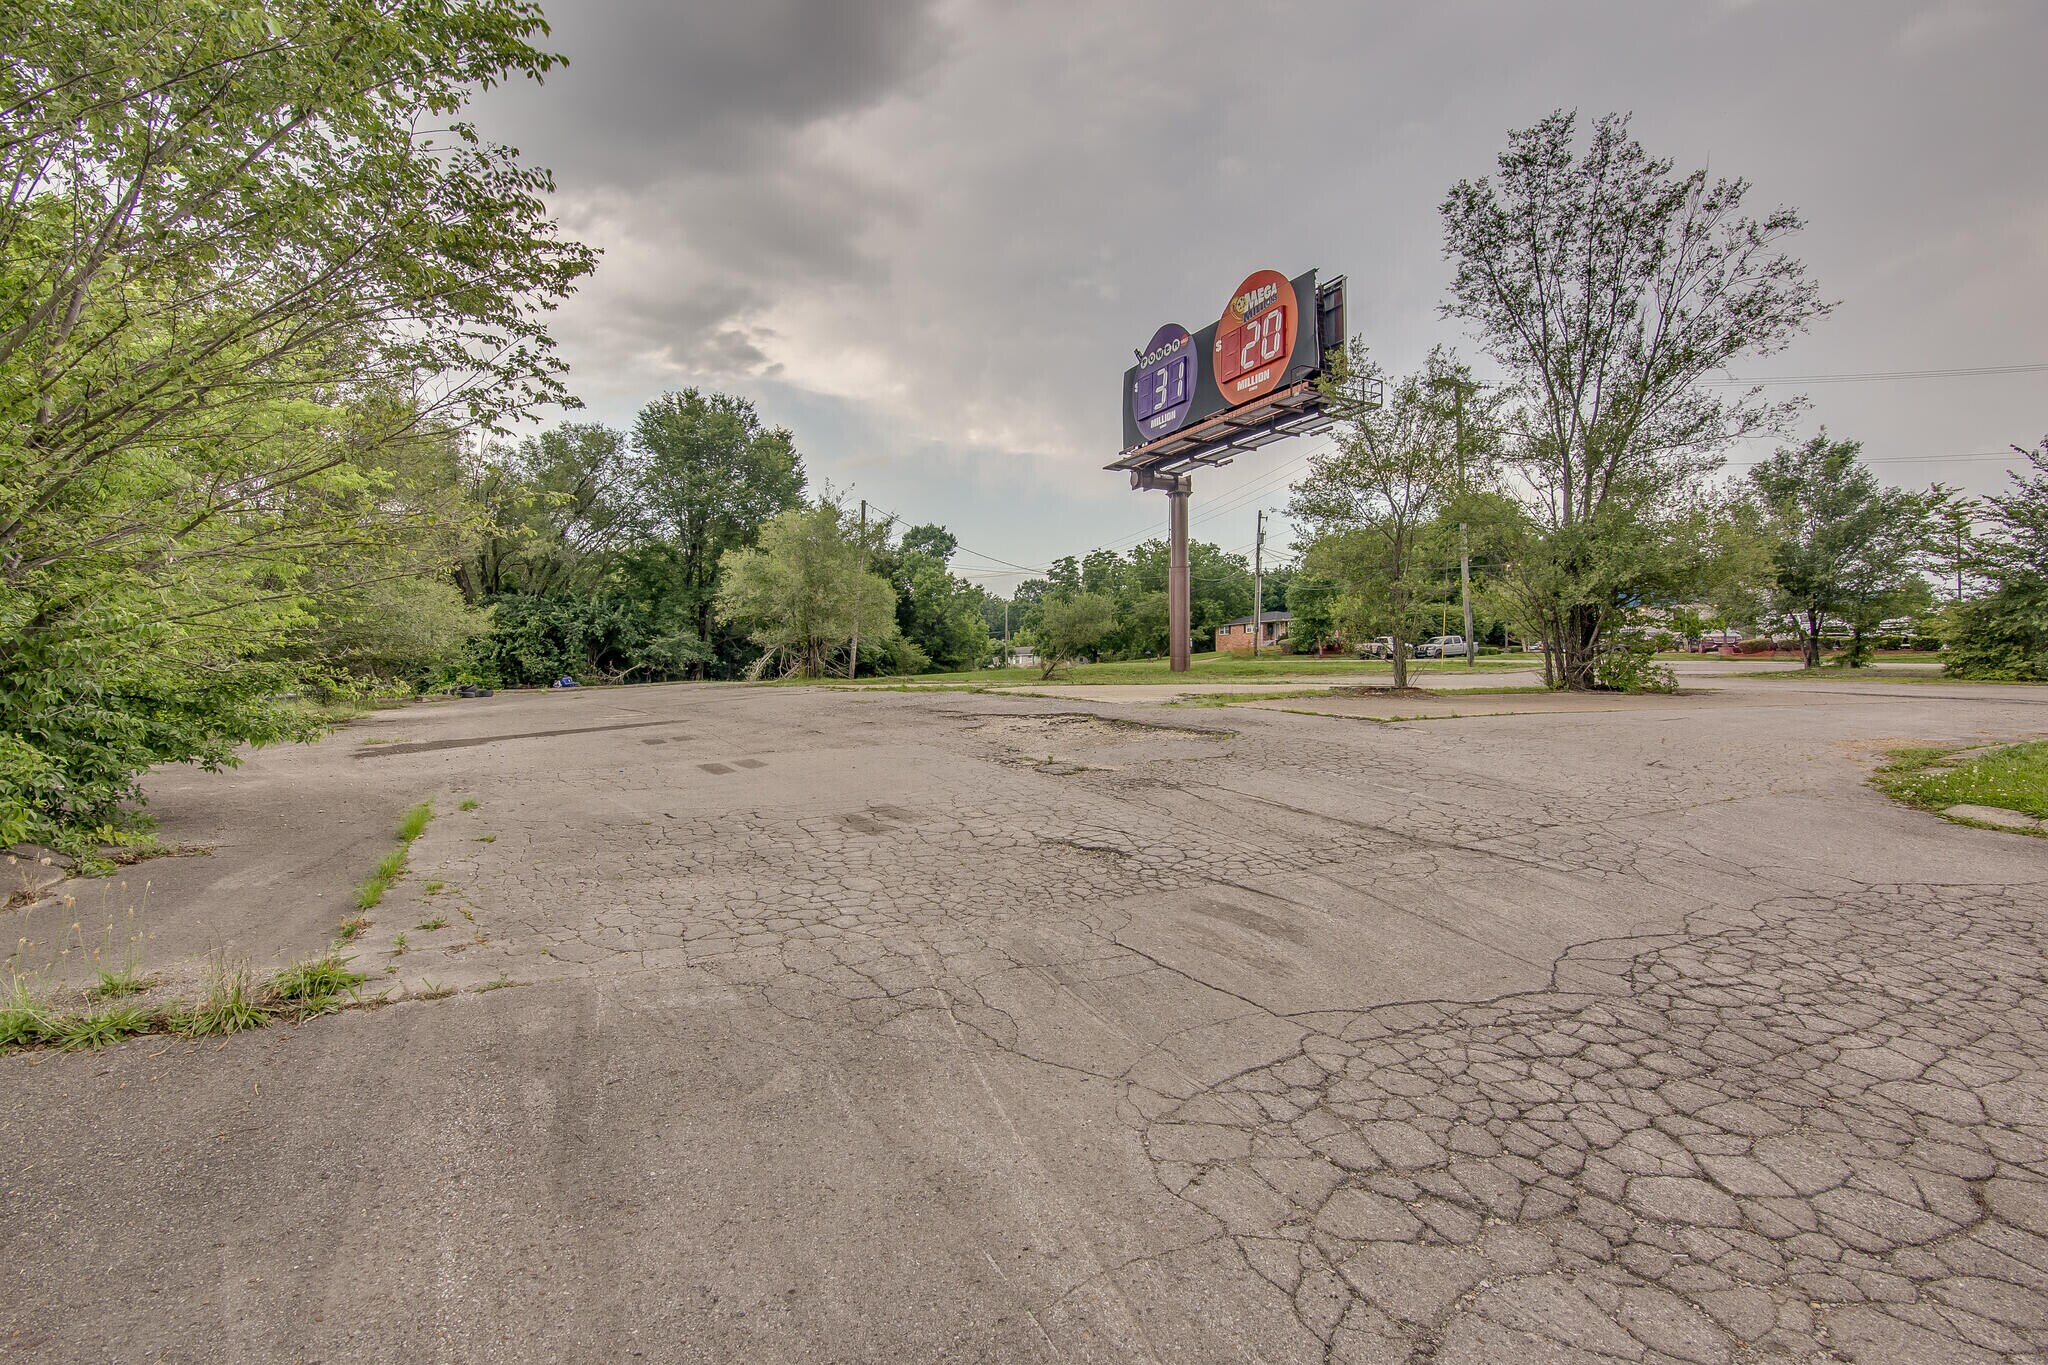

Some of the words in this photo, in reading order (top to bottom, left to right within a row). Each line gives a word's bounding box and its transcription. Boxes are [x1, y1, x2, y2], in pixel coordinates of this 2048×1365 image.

[1243, 283, 1278, 312] MEGA
[1240, 309, 1282, 369] 20
[1141, 339, 1180, 369] POWER
[1154, 361, 1184, 411] 31
[1236, 369, 1270, 392] MILLION
[1150, 410, 1176, 429] MILLION
